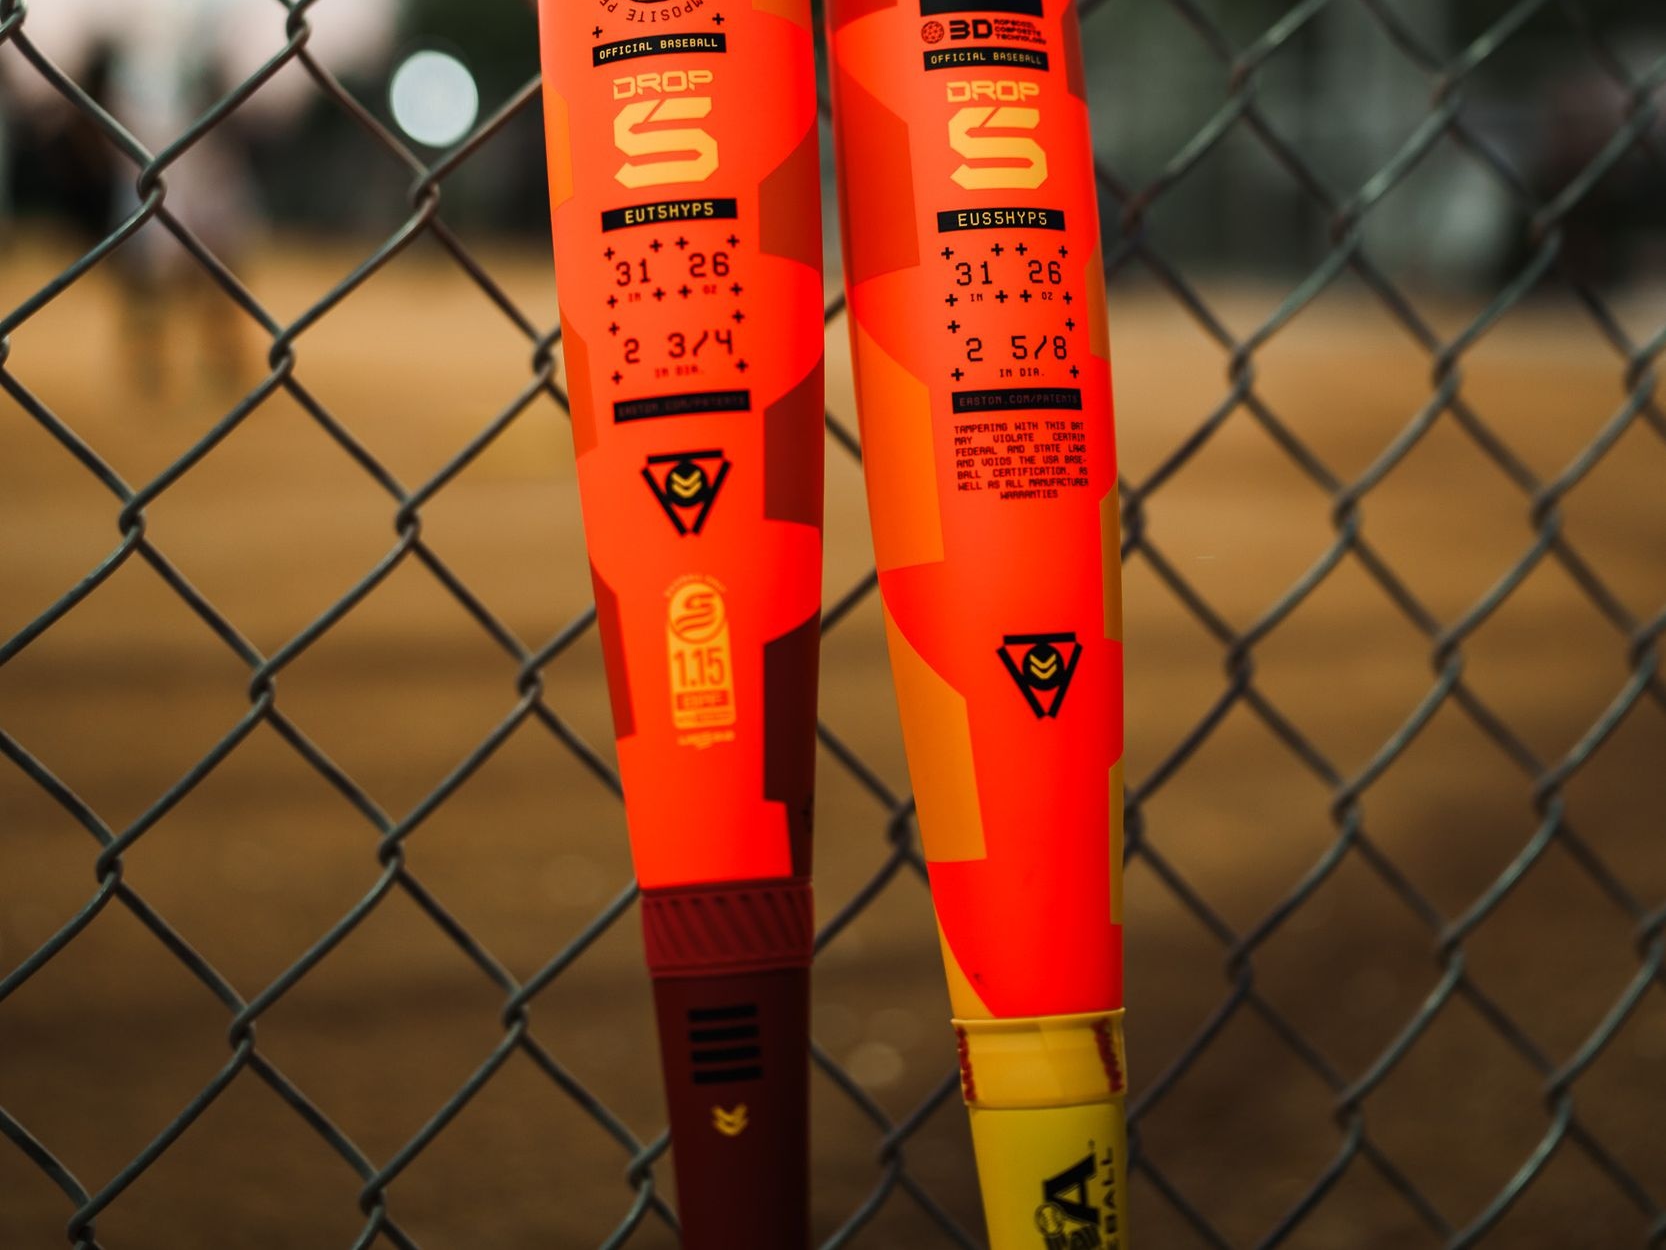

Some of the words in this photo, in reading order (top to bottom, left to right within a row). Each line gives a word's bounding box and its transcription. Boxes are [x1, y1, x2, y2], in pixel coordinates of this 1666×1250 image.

[949, 19, 993, 40] 3D
[600, 41, 652, 60] OFFICIAL
[660, 38, 718, 49] BASEBALL
[931, 52, 986, 65] OFFICIAL
[993, 52, 1042, 65] BASEBALL
[612, 70, 713, 100] DROP
[946, 80, 1040, 102] DROP
[616, 258, 651, 287] 31
[689, 252, 730, 278] 26
[955, 261, 993, 286] 31
[1028, 260, 1062, 285] 26
[970, 293, 983, 303] IN
[1042, 291, 1053, 301] OZ
[624, 338, 640, 364] 2
[667, 330, 733, 358] 3/4
[966, 338, 983, 362] 2
[1011, 335, 1067, 360] 5/8
[1000, 368, 1013, 378] IN
[954, 423, 1008, 434] TAMPERING
[1014, 422, 1039, 431] WITH
[1045, 421, 1066, 431] THIS
[955, 436, 972, 446] MAY
[993, 433, 1034, 443] VIOLATE
[1052, 432, 1086, 442] CERTAIN
[956, 446, 998, 457] FEDERAL
[1007, 444, 1025, 454] AND
[1034, 443, 1061, 453] STATE
[957, 458, 975, 468] AND
[981, 456, 1012, 467] VOIDS
[1019, 455, 1036, 465] THE
[1042, 454, 1059, 464] USA
[958, 470, 981, 480] BALL
[958, 481, 982, 491] WELL
[988, 480, 1000, 489] AS
[1005, 479, 1024, 488] ALL
[674, 647, 725, 688] 1.15
